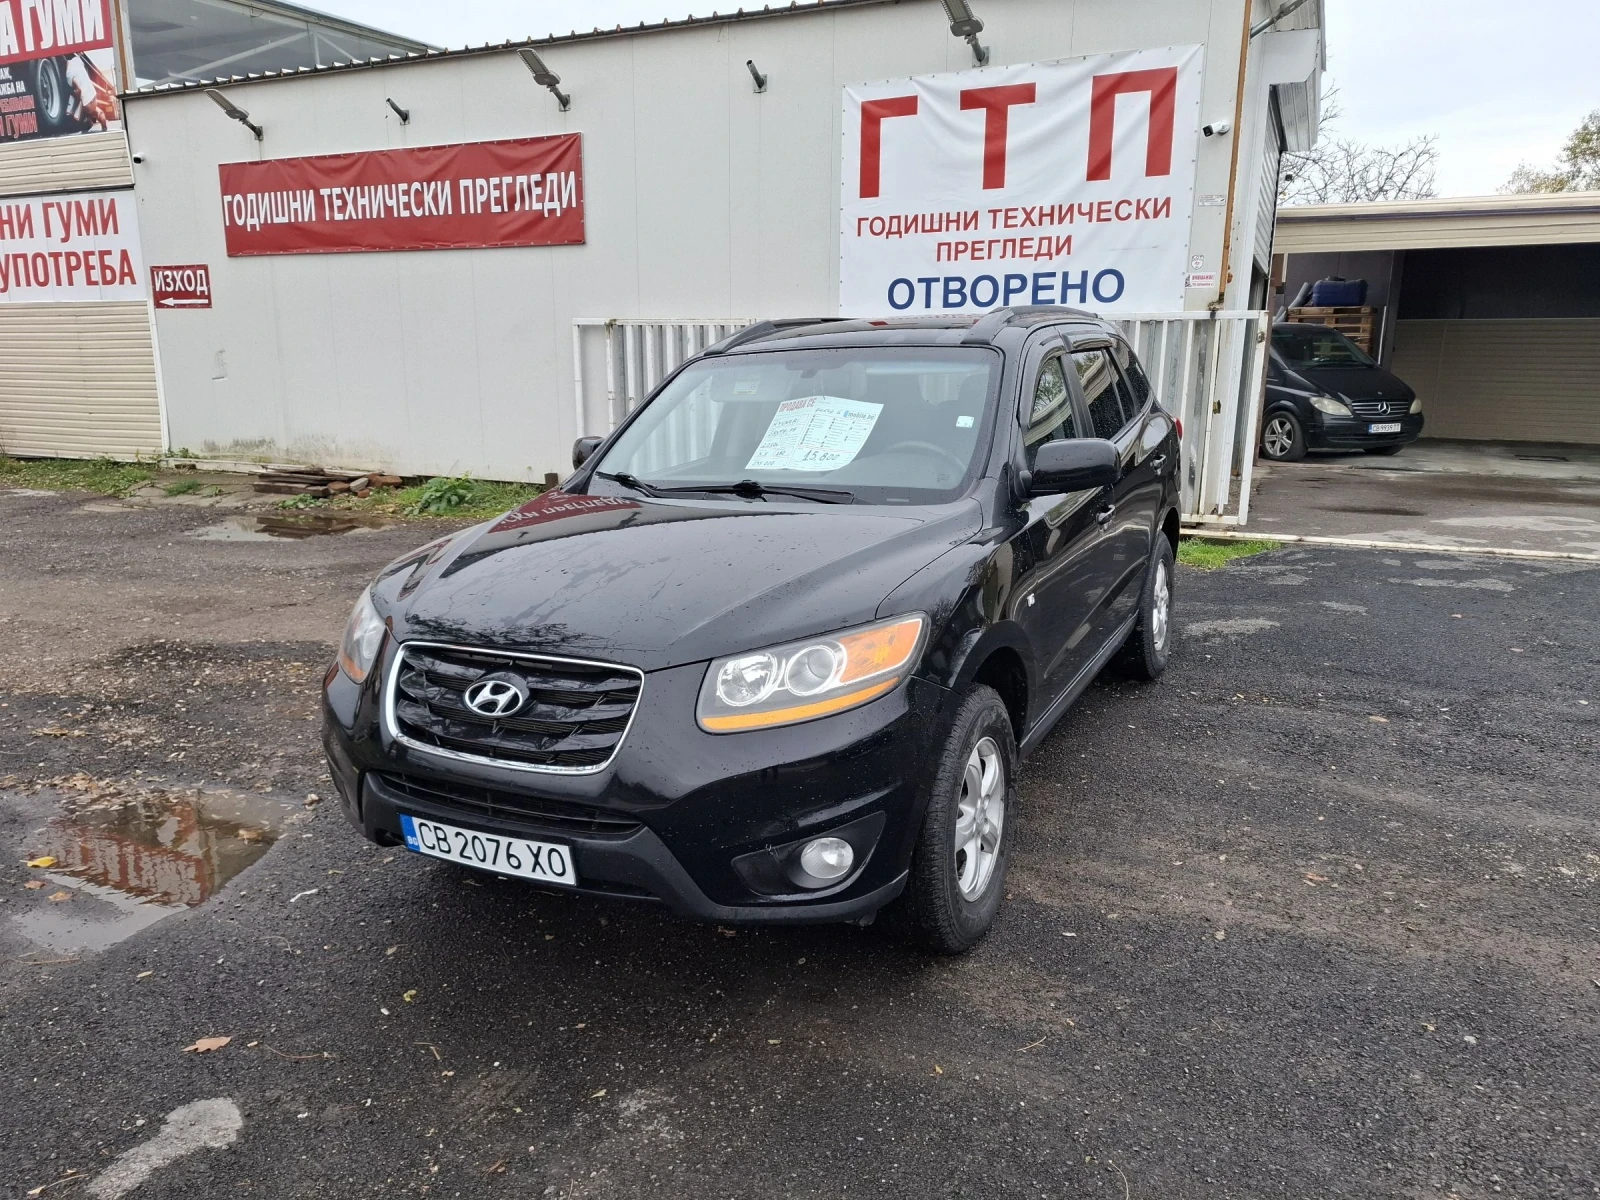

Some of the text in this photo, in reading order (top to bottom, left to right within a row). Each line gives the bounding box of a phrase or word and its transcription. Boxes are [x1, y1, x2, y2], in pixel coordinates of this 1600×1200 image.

[20, 0, 104, 52] ГУМИ
[15, 80, 26, 93] НА
[5, 112, 37, 138] ГУМИ
[859, 65, 1178, 198] ГТП
[42, 198, 119, 243] ГУМИ
[222, 171, 577, 231] ГОДИШНИ ТЕХНИЧЕСКИ ПРЕГЛЕДИ
[857, 196, 1171, 239] ГОДИШНИ ТЕХНИЧЕСКИ
[936, 234, 1073, 262] ПРЕГЛЕДИ
[154, 269, 208, 295] ИЗХОД
[887, 268, 1125, 310] ОТВОРЕНО
[407, 836, 418, 846] BG
